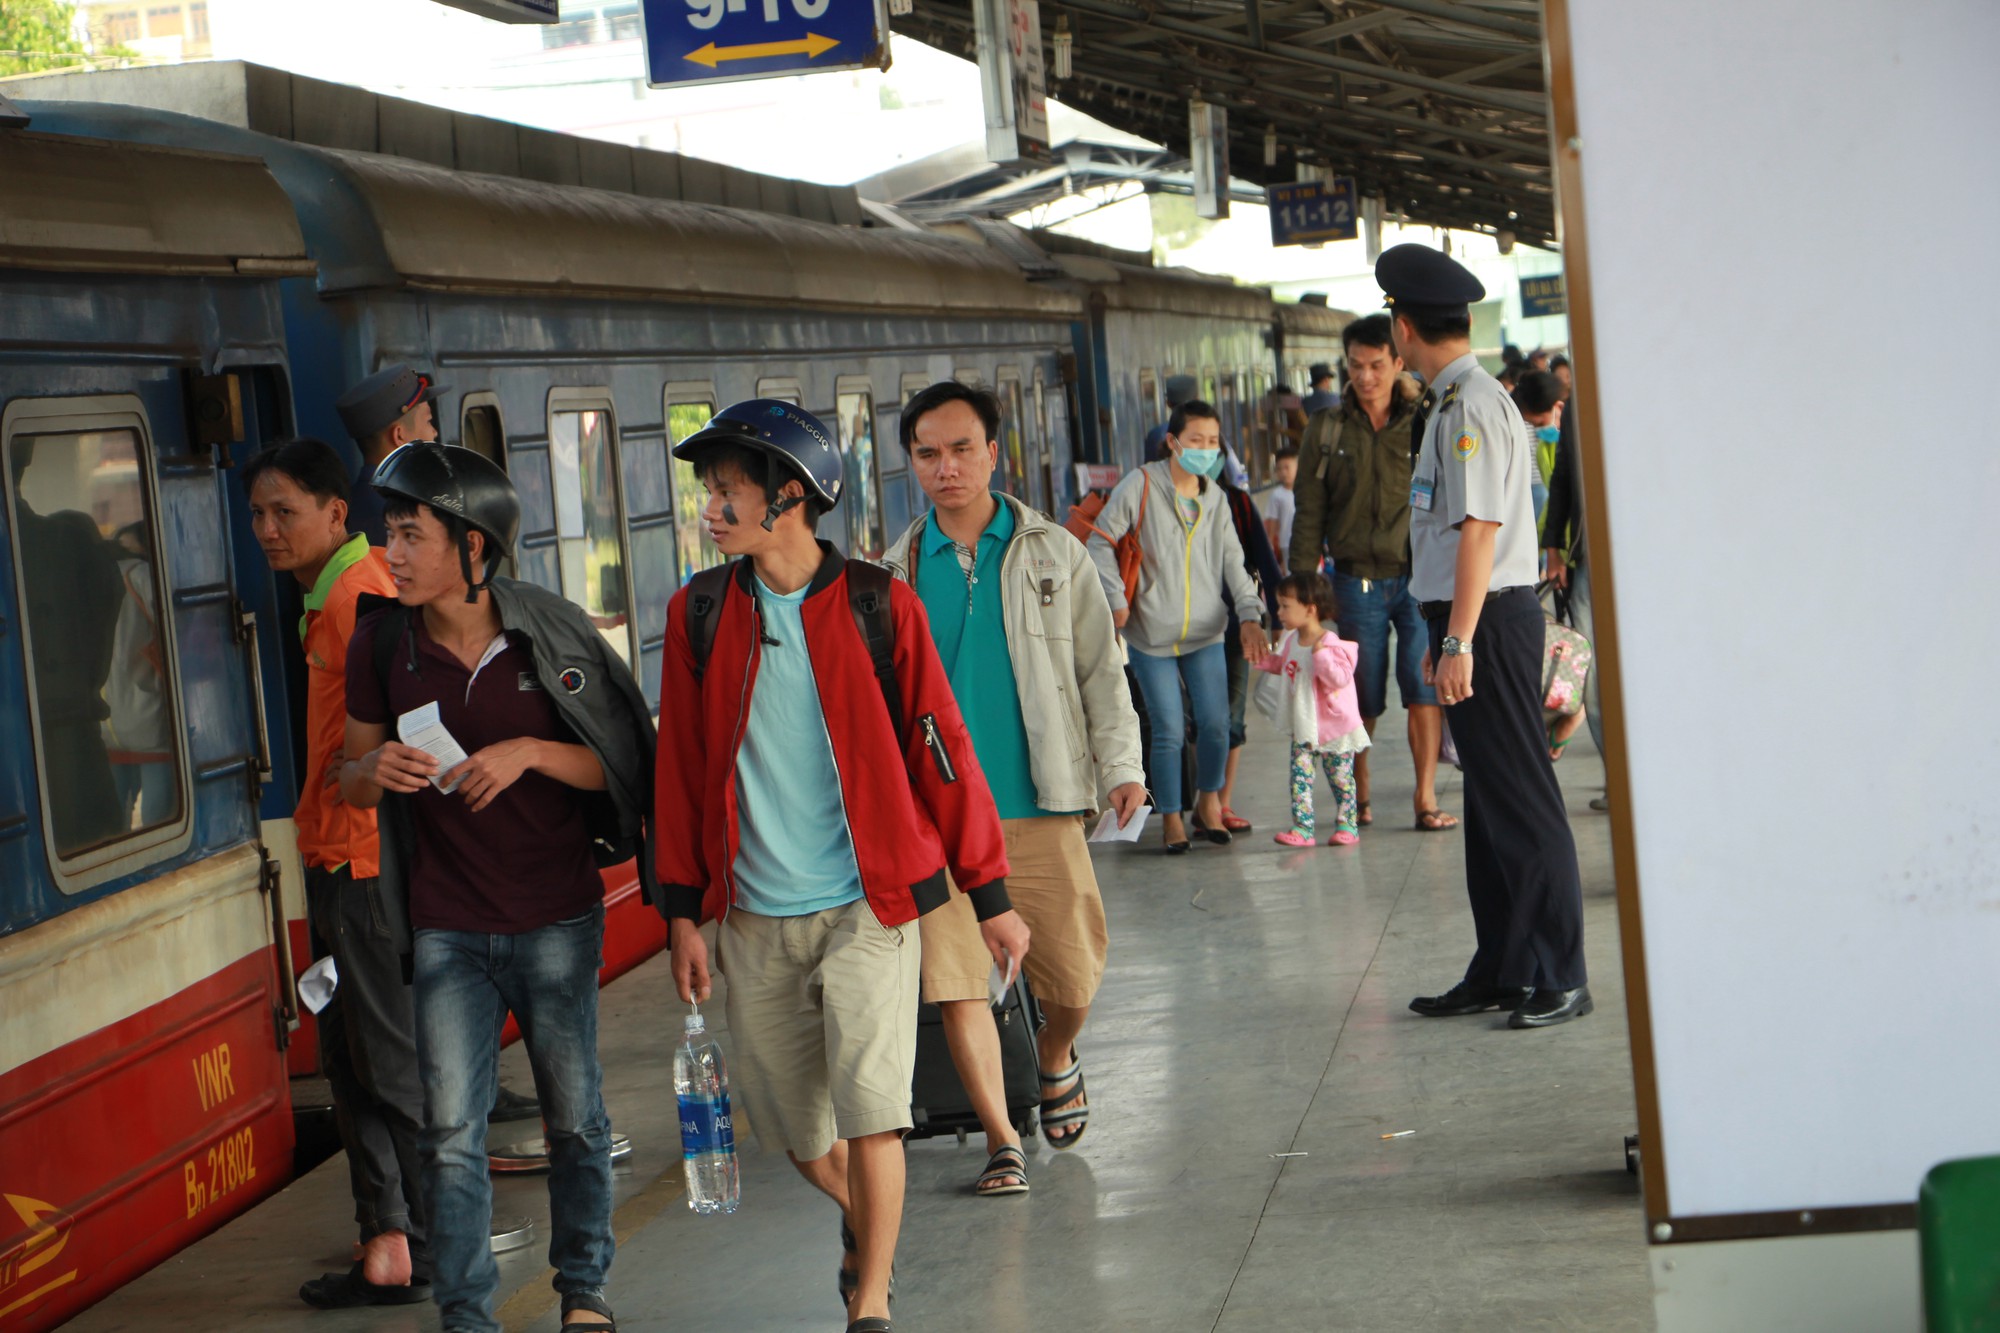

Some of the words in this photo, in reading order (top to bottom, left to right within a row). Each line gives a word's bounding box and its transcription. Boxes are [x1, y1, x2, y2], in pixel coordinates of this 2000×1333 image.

[1280, 201, 1350, 228] 11-12
[786, 411, 830, 452] PIAGGIO
[192, 1042, 235, 1112] VNR
[184, 1160, 206, 1220] Bn
[208, 1126, 256, 1204] 21802
